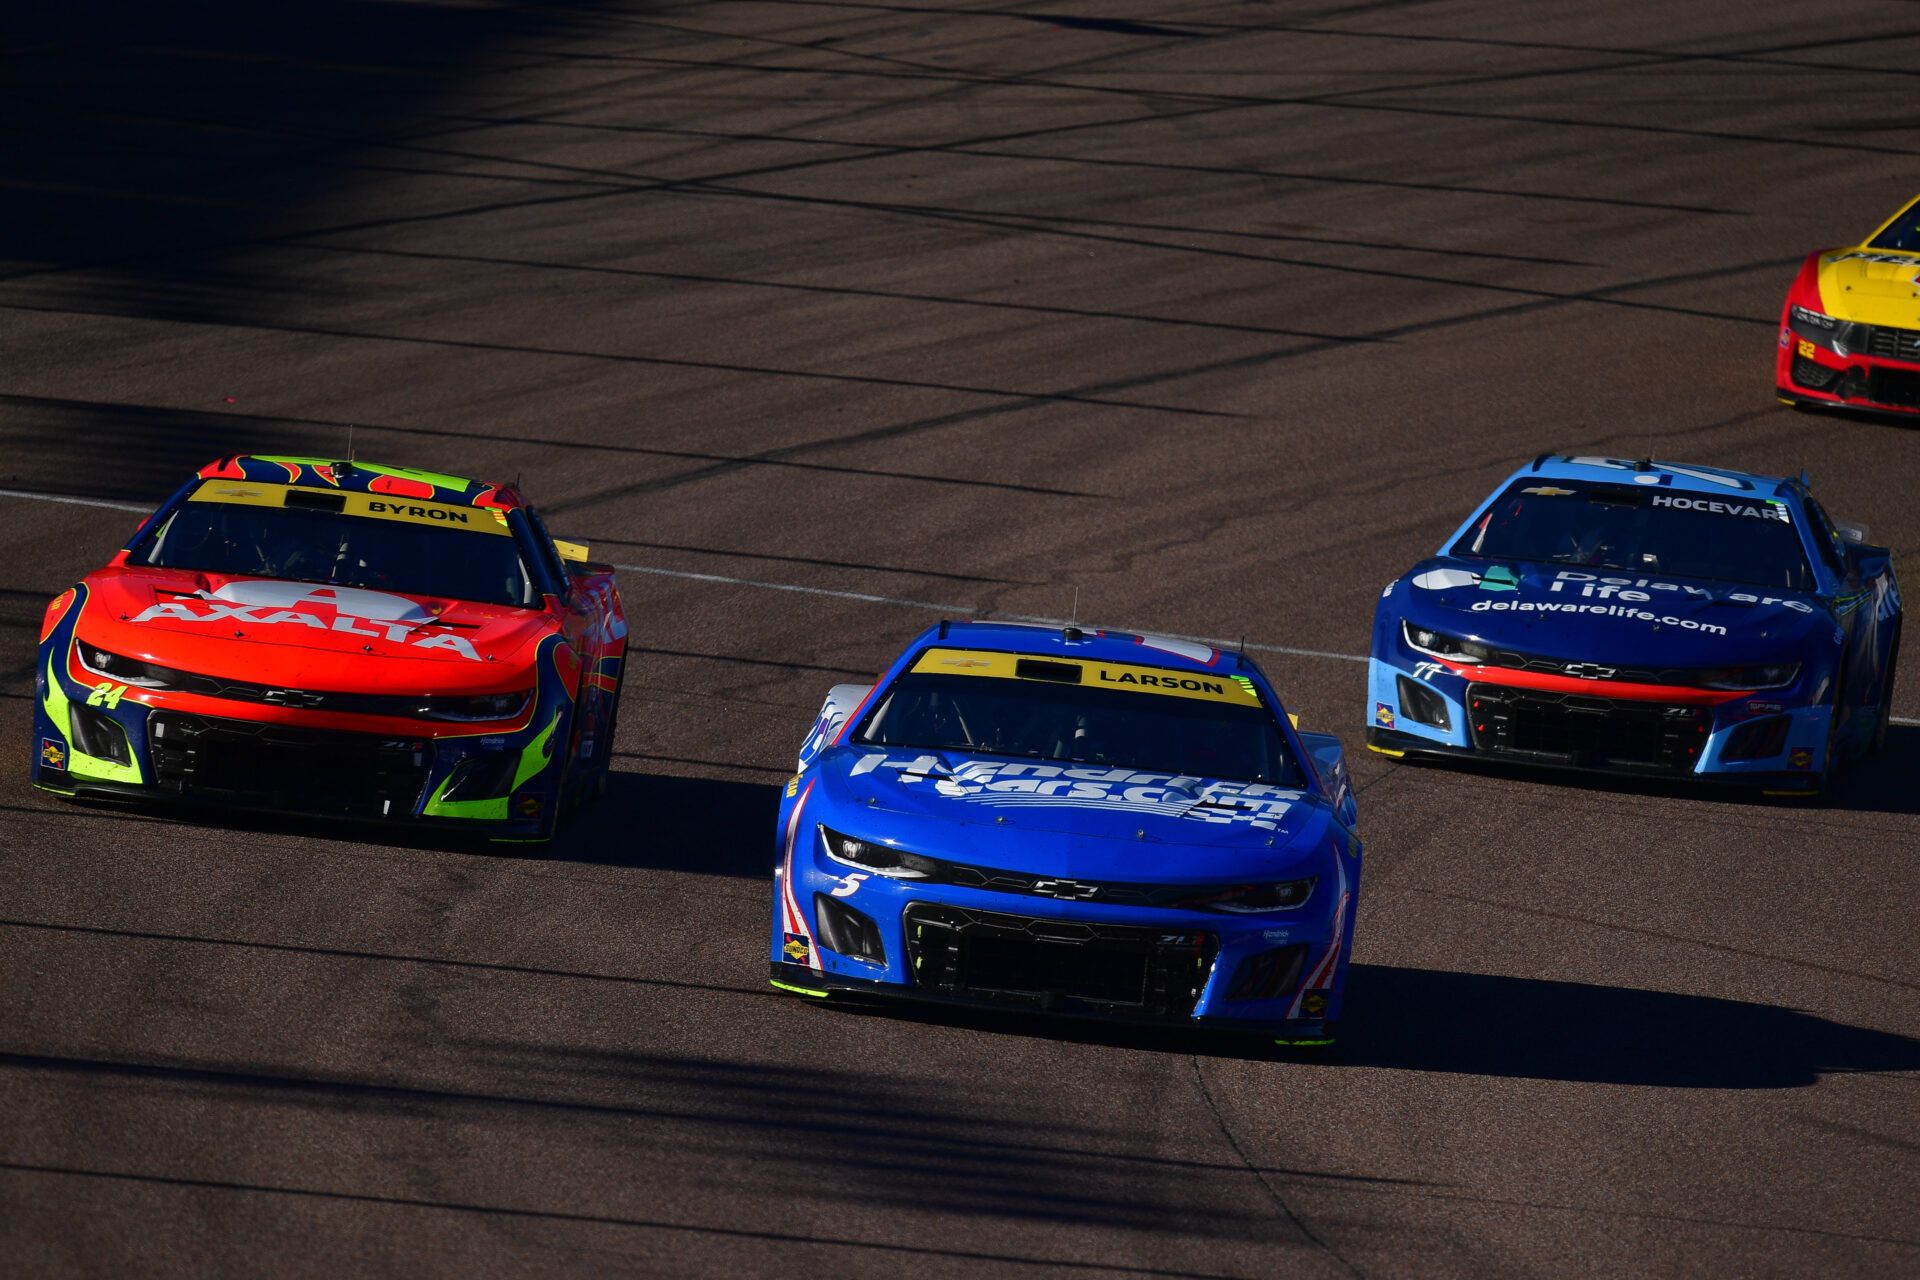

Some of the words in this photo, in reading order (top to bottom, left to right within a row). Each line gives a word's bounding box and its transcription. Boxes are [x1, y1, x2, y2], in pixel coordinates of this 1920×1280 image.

[1798, 340, 1815, 359] 22
[368, 501, 468, 524] BYRON
[1652, 495, 1781, 521] HOCEVAR
[1471, 600, 1727, 635] delawarelife.com
[129, 602, 482, 661] AXALTA
[1100, 670, 1223, 694] LARSON
[86, 682, 128, 709] 24
[831, 873, 869, 897] 5
[784, 943, 809, 955] SUNOCO
